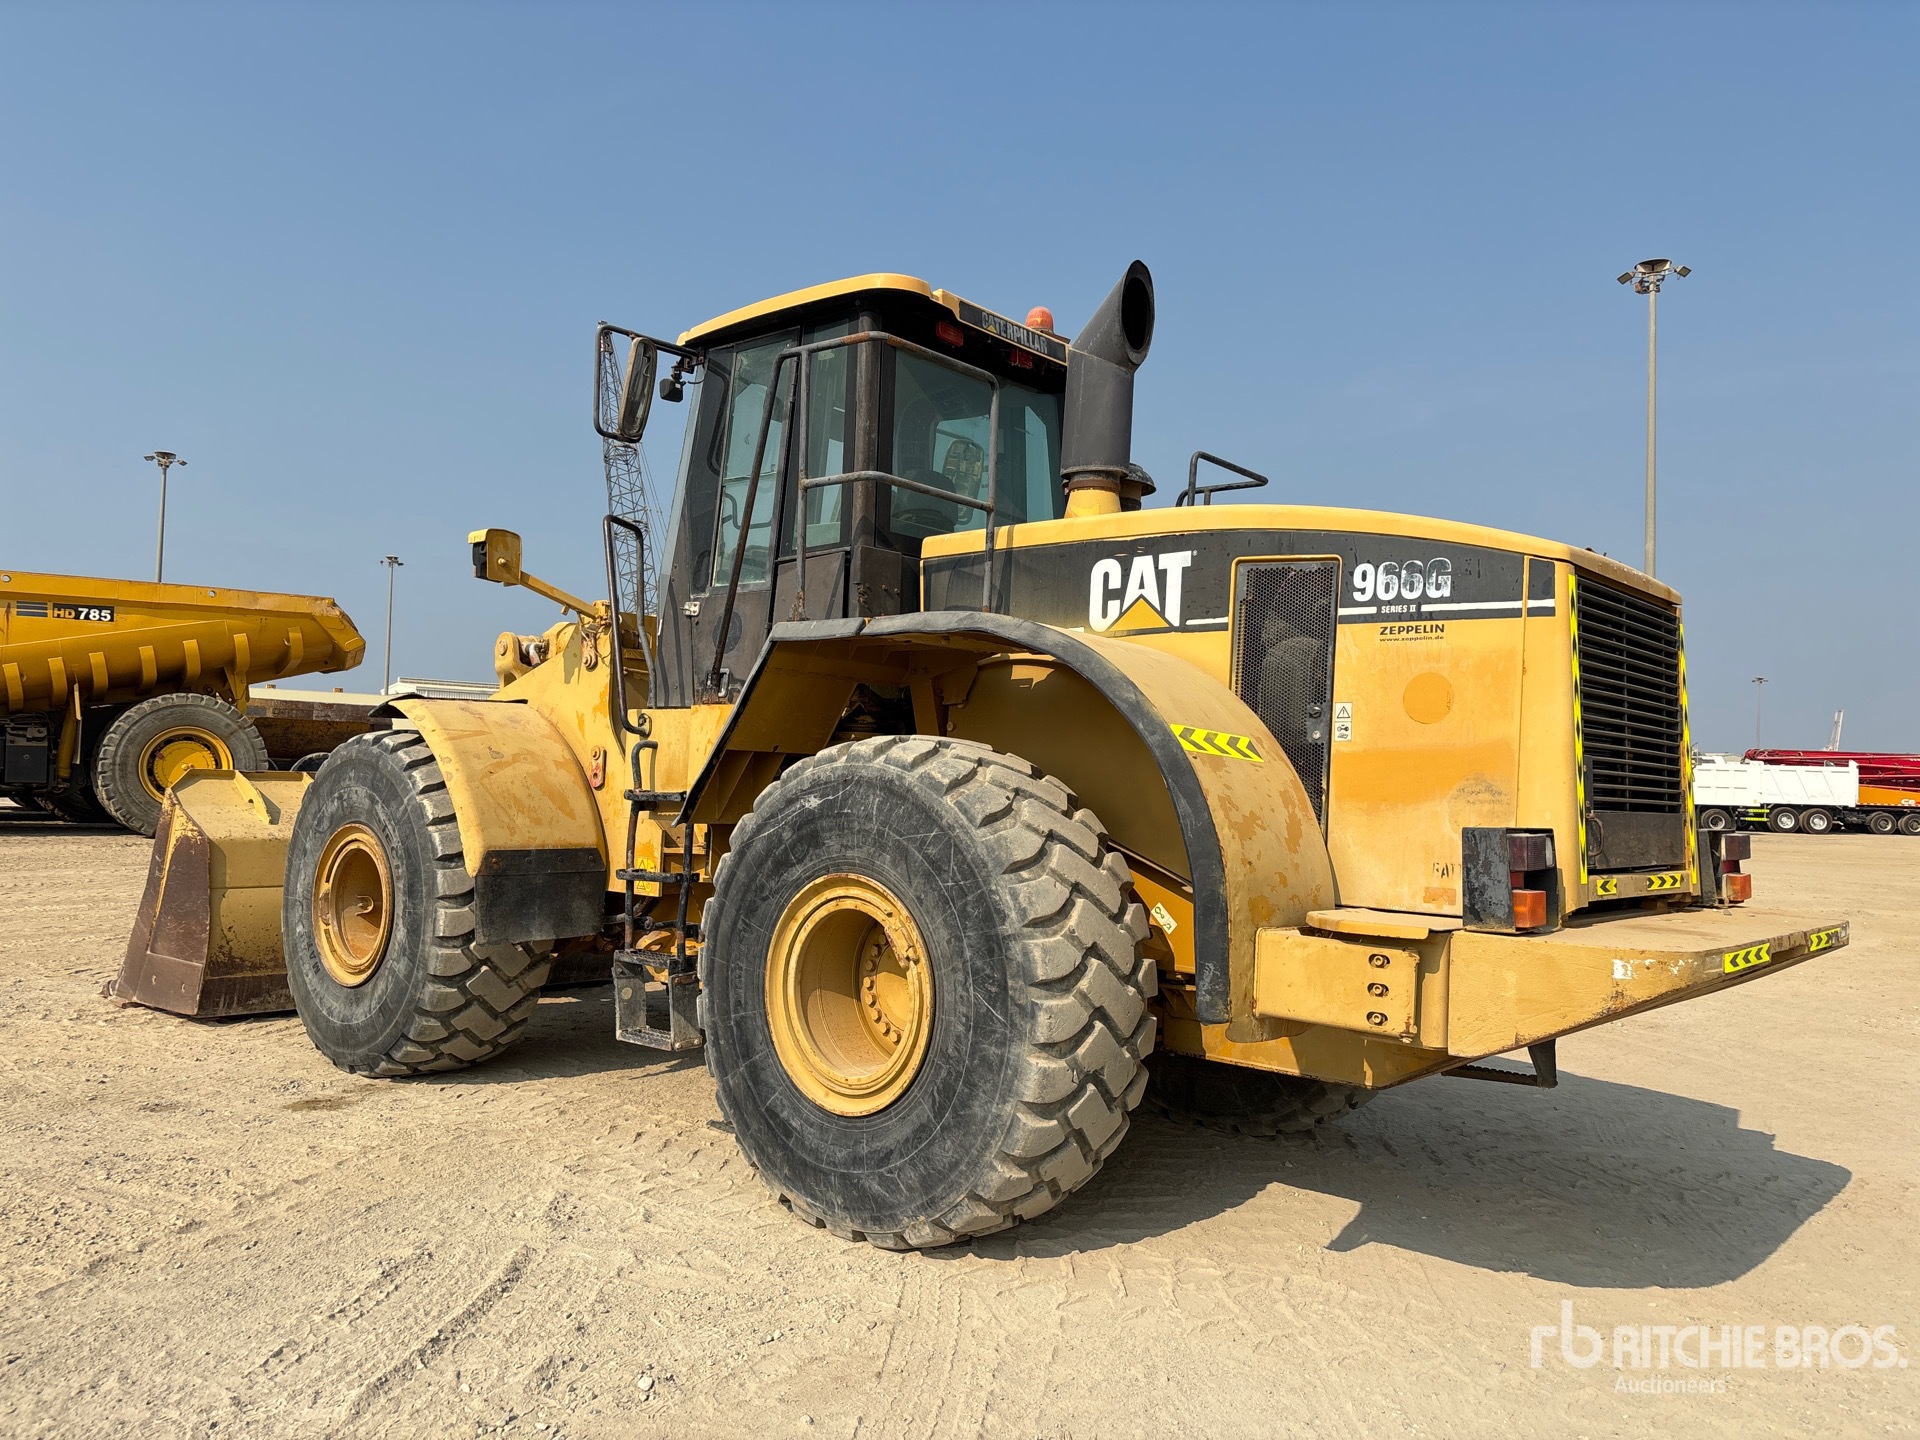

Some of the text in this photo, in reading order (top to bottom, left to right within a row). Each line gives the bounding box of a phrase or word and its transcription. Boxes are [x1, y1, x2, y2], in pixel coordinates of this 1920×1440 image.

[981, 311, 1048, 354] CATERPILLAR
[1089, 551, 1192, 632] CAT
[1353, 557, 1452, 602] 966G
[53, 607, 112, 622] HD 785
[1381, 605, 1408, 614] SERIES
[1380, 624, 1445, 636] ZEPPELIN
